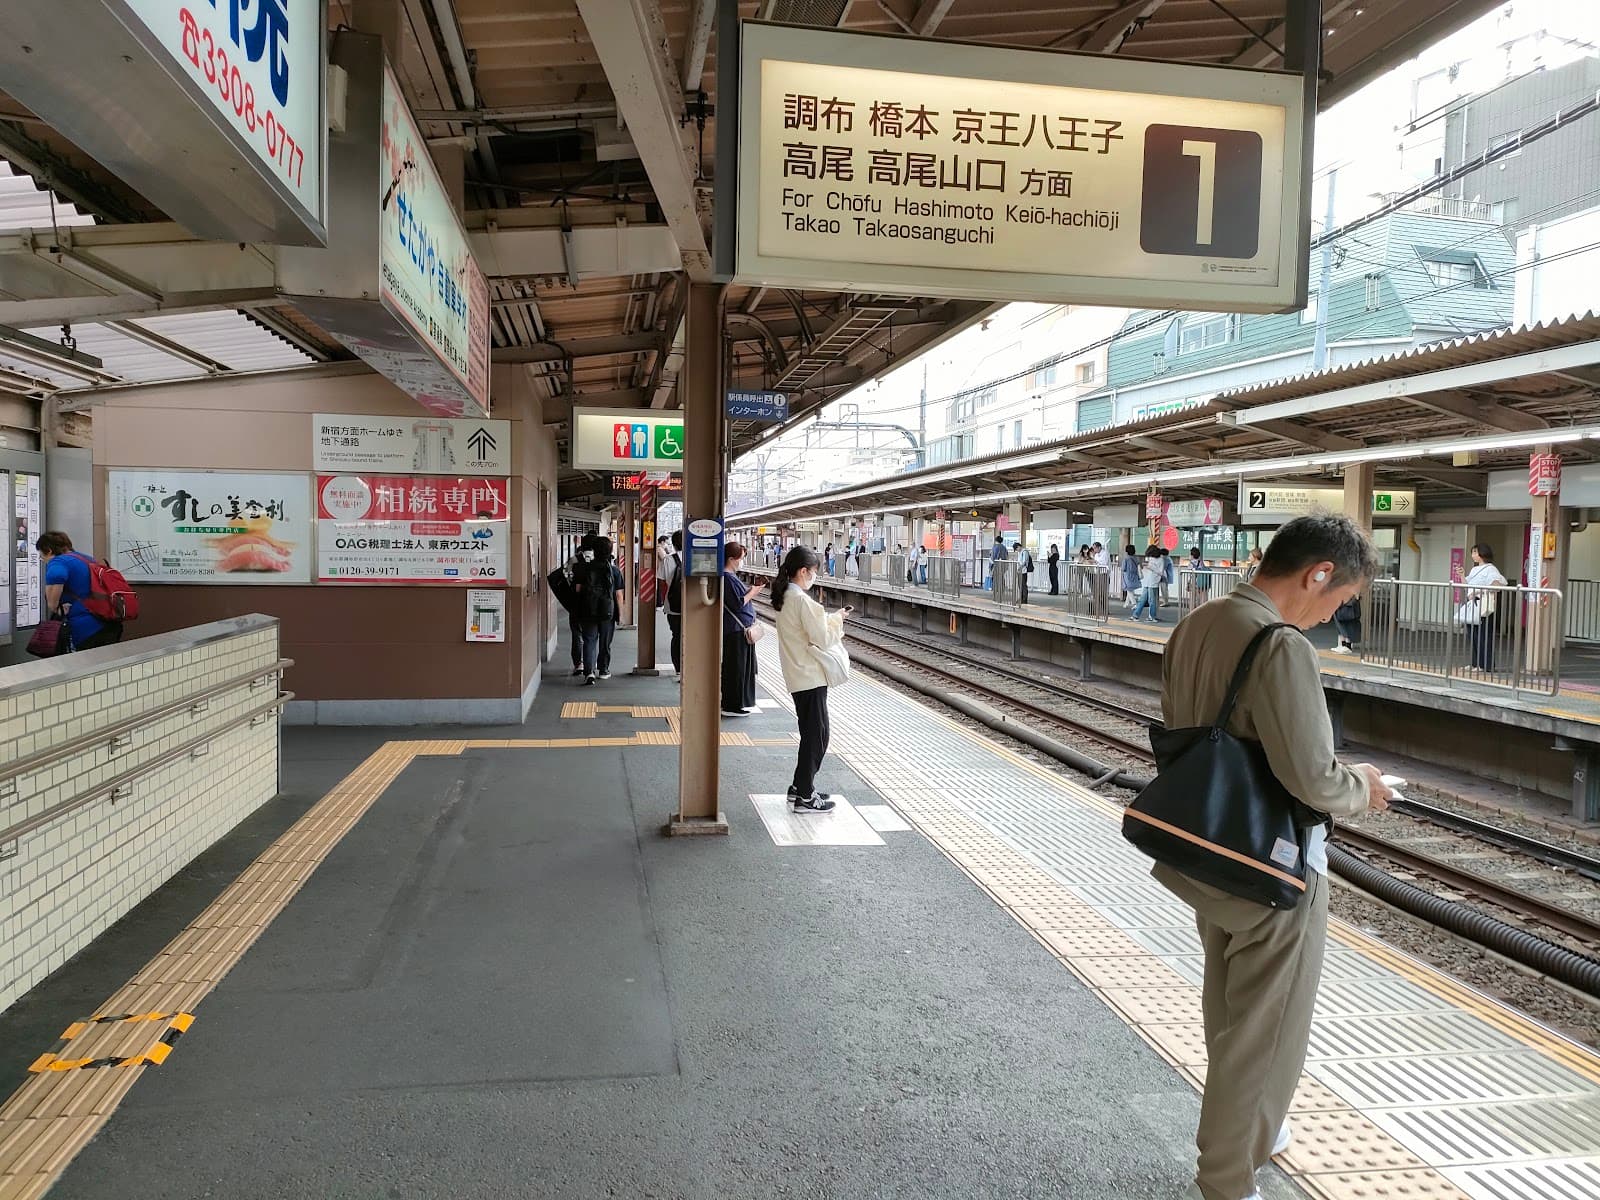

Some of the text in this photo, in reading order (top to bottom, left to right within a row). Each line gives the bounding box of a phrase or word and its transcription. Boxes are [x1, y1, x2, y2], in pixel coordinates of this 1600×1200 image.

[202, 27, 304, 188] 3308-0777
[783, 93, 1124, 155] 調布 橋本 京王八王子
[782, 141, 1073, 198] 高尾 高尾山口 方面
[1181, 138, 1217, 246] 1
[782, 187, 1120, 231] For Chōfu Hashimoto Keiō-hachiōji
[396, 191, 436, 288] せたがや
[781, 212, 995, 244] Takao Takaosanguchi
[728, 406, 773, 416] インターホン
[320, 425, 404, 438] 新宿方面ホームゆき
[320, 436, 360, 447] 地下通路
[160, 489, 285, 523] すしの美登利
[376, 484, 499, 515] 相続専門
[1252, 492, 1263, 508] 2
[335, 538, 489, 551] OAG税理士法人 東京ウエスト
[339, 566, 400, 576] 0120-39-9171
